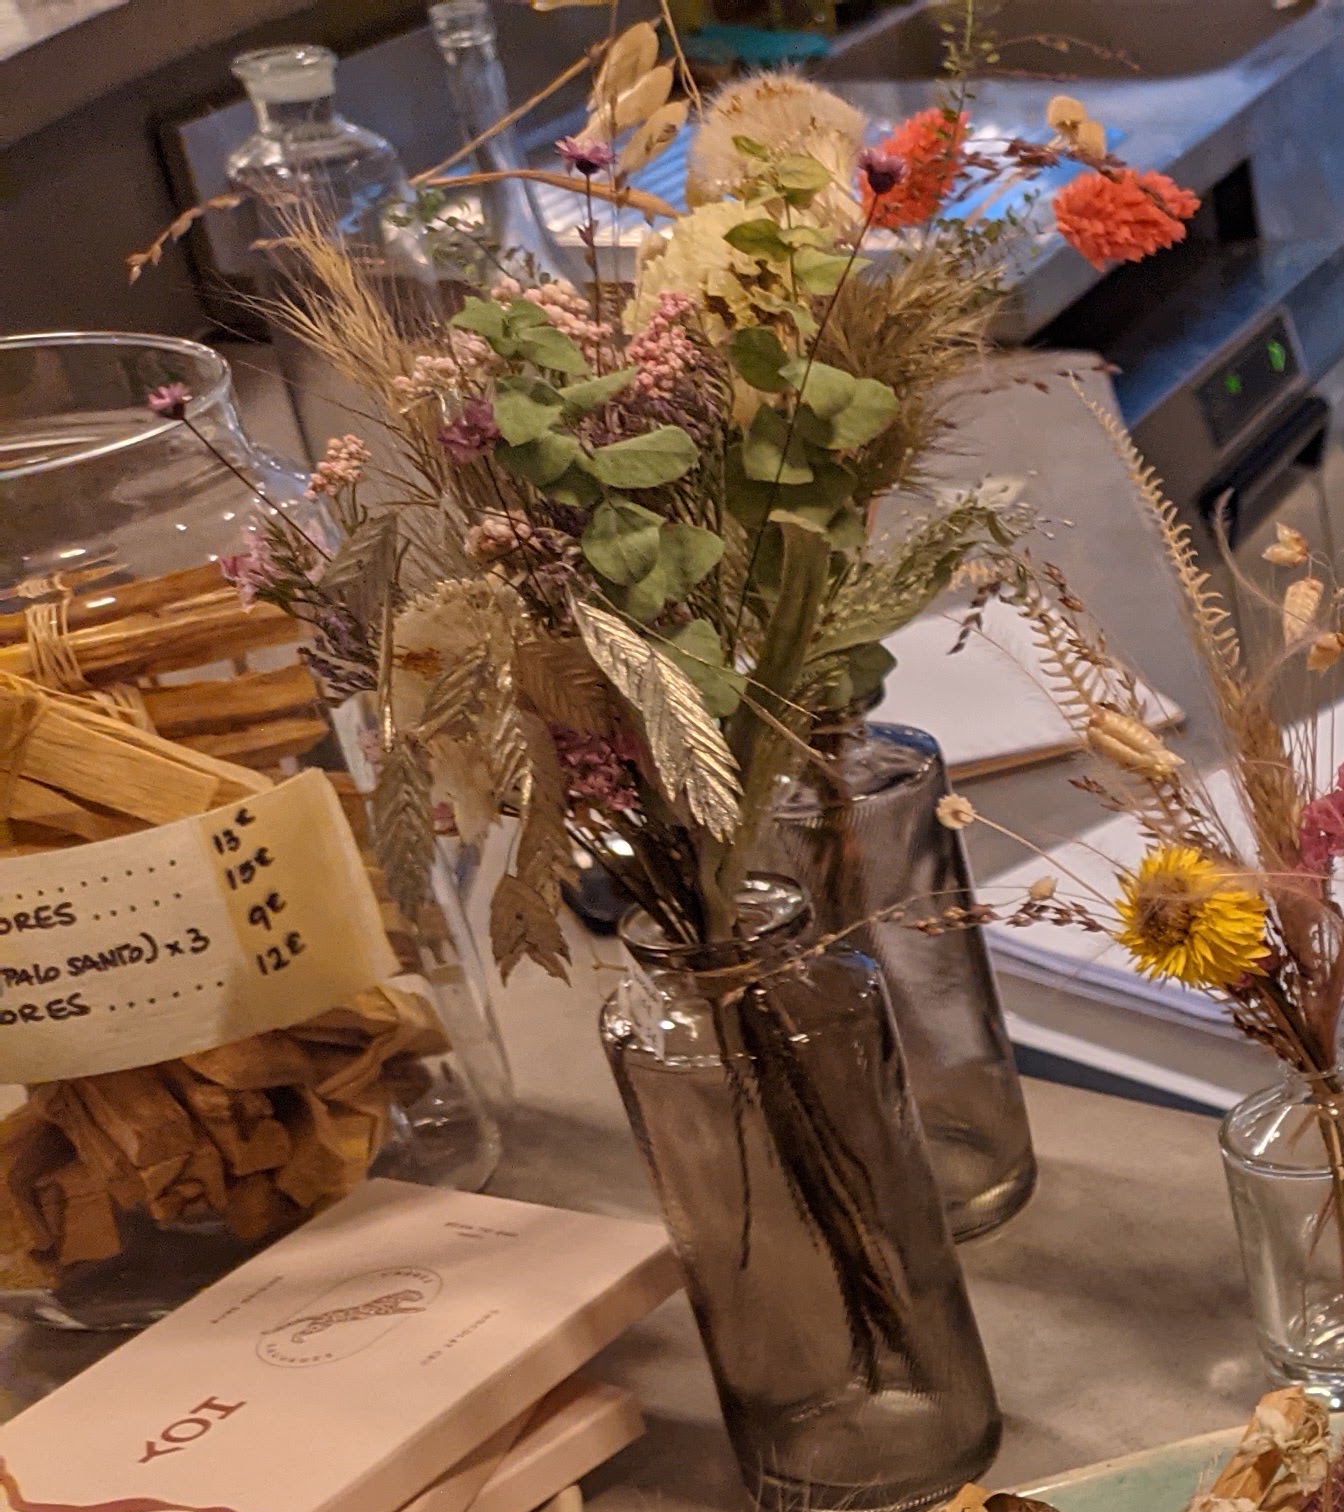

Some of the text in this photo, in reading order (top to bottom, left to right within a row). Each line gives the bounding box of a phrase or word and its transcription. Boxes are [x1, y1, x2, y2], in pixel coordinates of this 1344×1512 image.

[248, 891, 287, 931] 9€
[256, 931, 306, 976] 12€
[138, 1396, 247, 1464] YOI
